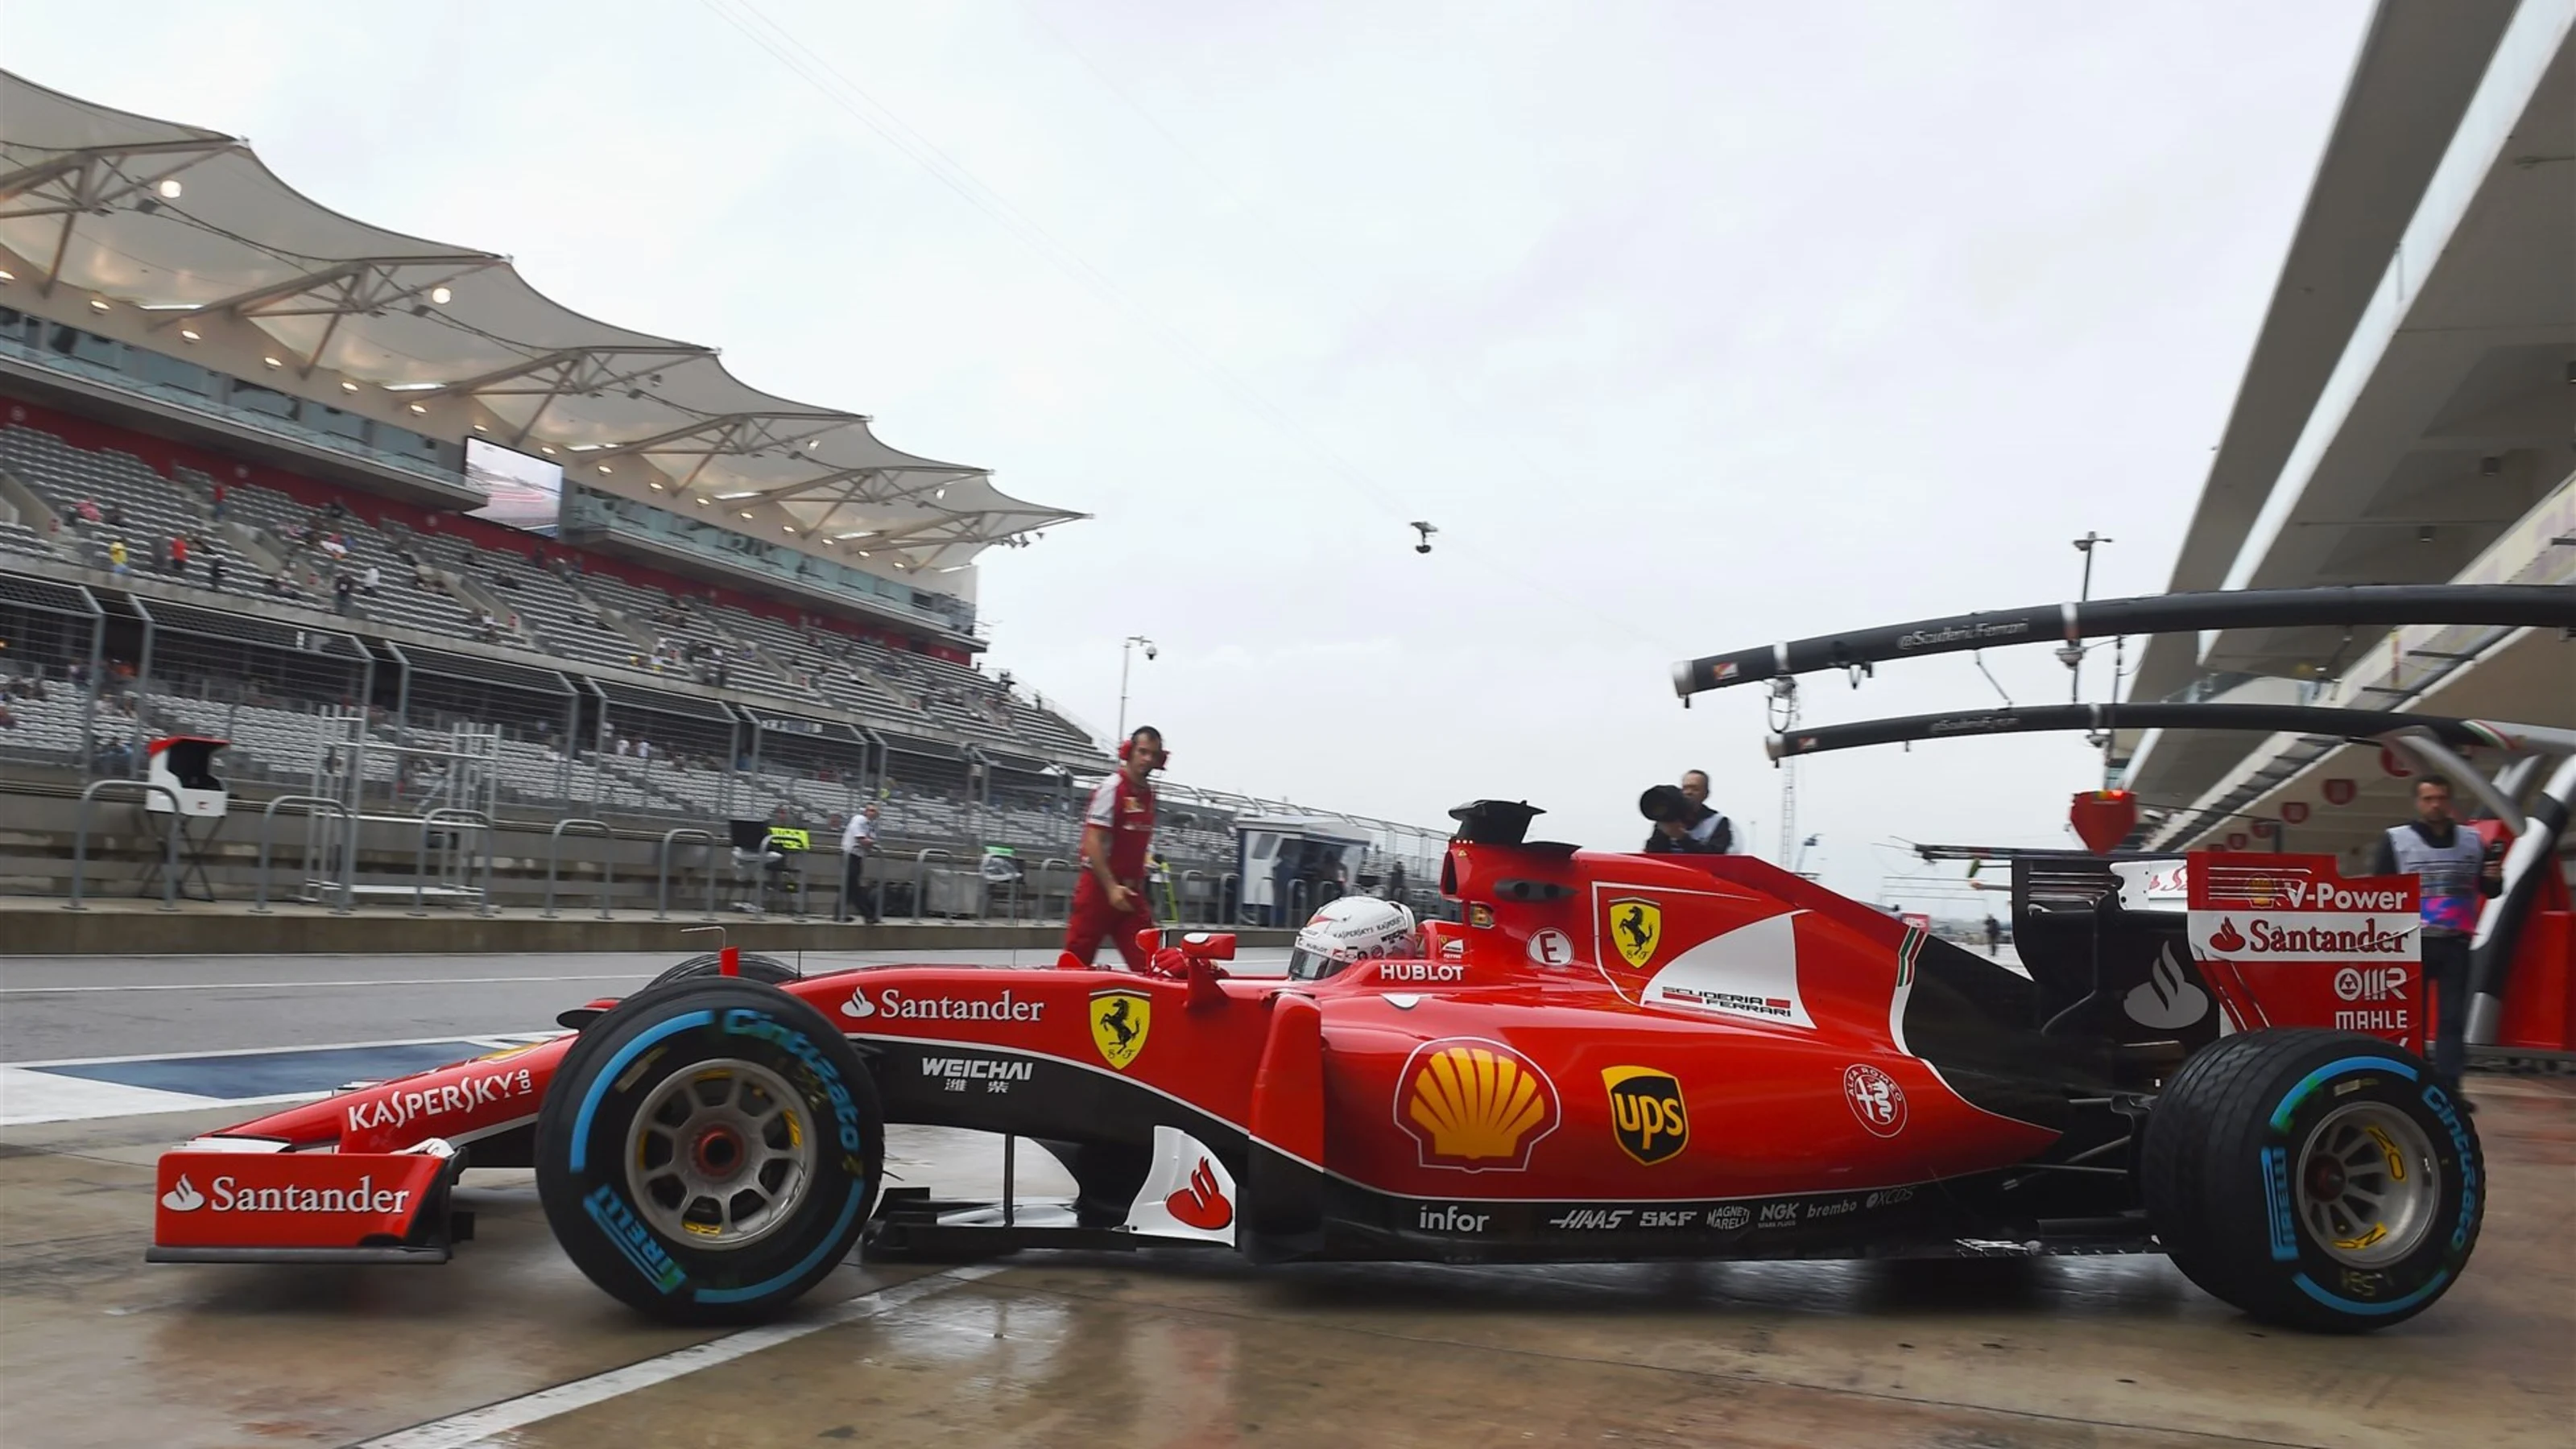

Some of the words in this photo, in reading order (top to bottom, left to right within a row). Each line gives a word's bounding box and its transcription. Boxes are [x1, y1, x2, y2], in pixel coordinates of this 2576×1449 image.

[2286, 881, 2409, 910] V-Power
[1539, 933, 1561, 964] E
[2250, 918, 2409, 953] Santander
[1379, 964, 1464, 981] HUBLOT
[880, 989, 1044, 1022] Santander
[1662, 986, 1764, 1006] SCUDERIA
[1706, 999, 1792, 1018] FERRARI
[2336, 1009, 2407, 1030] MAHLE
[515, 1067, 532, 1096] lab
[921, 1058, 1033, 1080] WEICHAI
[1847, 1069, 1859, 1098] ALFA
[1860, 1067, 1902, 1102] ROMEO
[347, 1071, 515, 1132] KASPERSKY
[1614, 1092, 1684, 1151] ups
[2421, 1084, 2478, 1253] Cinturato
[211, 1174, 409, 1215] Santander
[1806, 1199, 1859, 1219] brembo
[2261, 1146, 2300, 1261] PIRELLI
[1419, 1204, 1490, 1232] infor
[1549, 1210, 1634, 1229] HAAS
[1639, 1211, 1697, 1227] SKF
[1759, 1203, 1799, 1220] NGK
